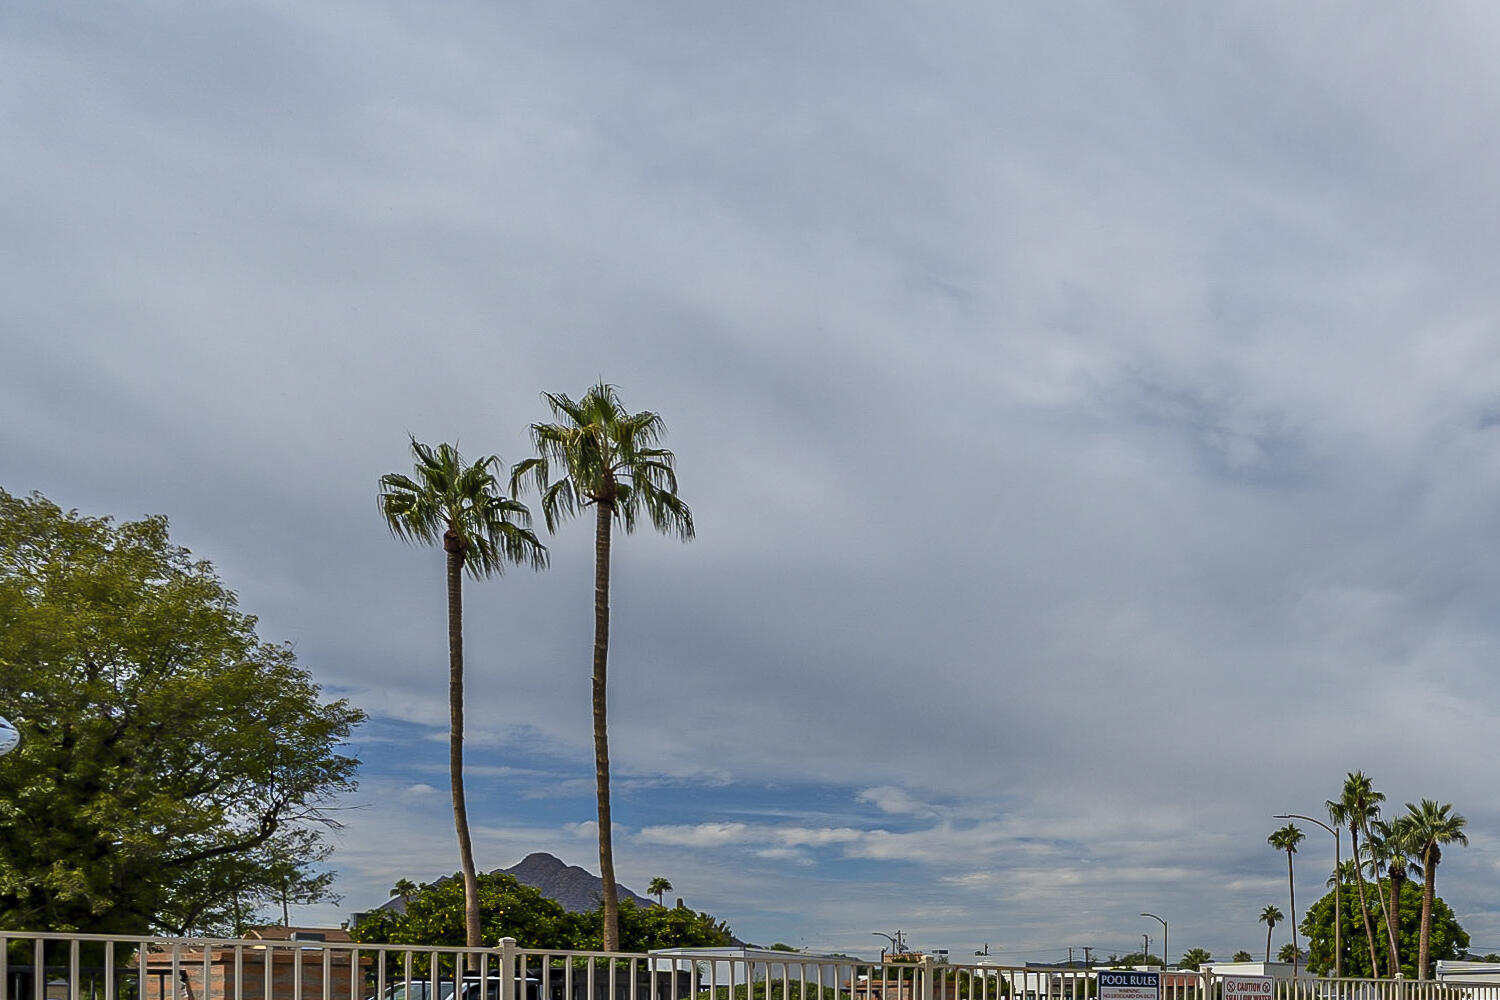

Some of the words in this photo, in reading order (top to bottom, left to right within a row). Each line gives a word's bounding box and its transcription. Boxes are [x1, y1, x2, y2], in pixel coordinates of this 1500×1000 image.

[1101, 975, 1129, 985] POOL
[1130, 975, 1157, 986] RULES
[1237, 982, 1262, 992] CAUTION
